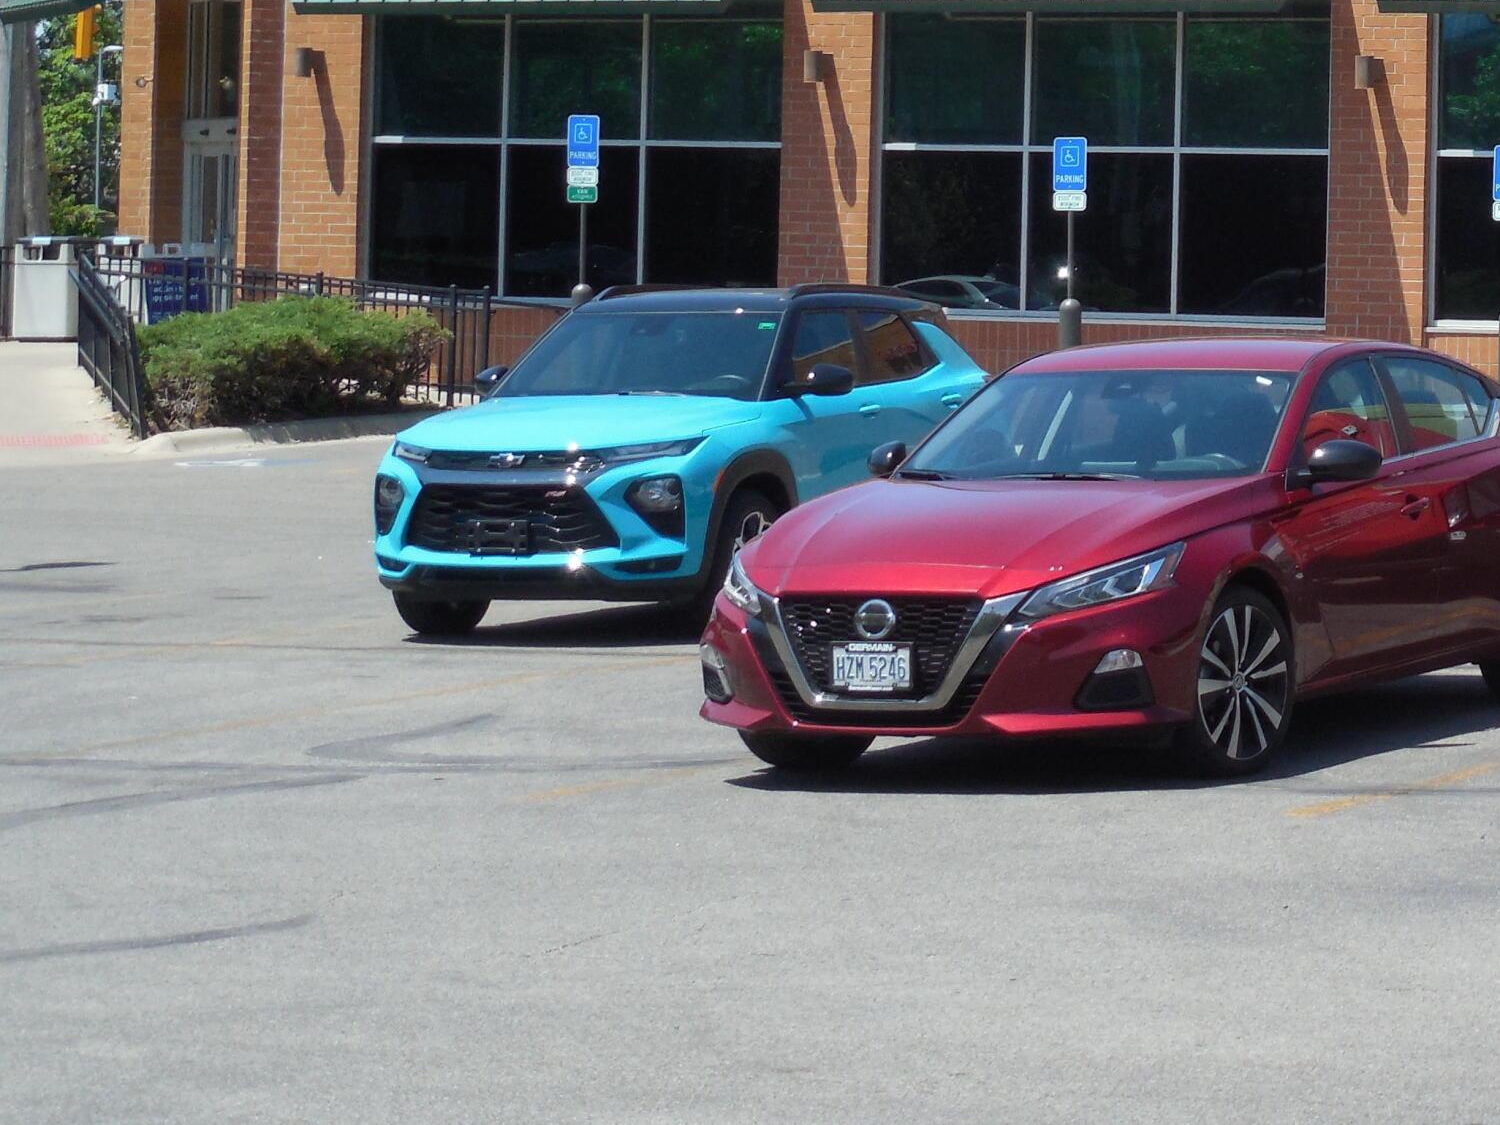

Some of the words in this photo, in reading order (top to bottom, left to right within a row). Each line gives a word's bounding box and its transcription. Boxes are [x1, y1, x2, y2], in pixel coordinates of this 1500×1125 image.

[569, 151, 597, 160] PARKING
[1055, 174, 1084, 183] PARKING
[848, 643, 894, 652] GERMAIN
[836, 656, 865, 680] HZM
[869, 656, 906, 681] 5246
